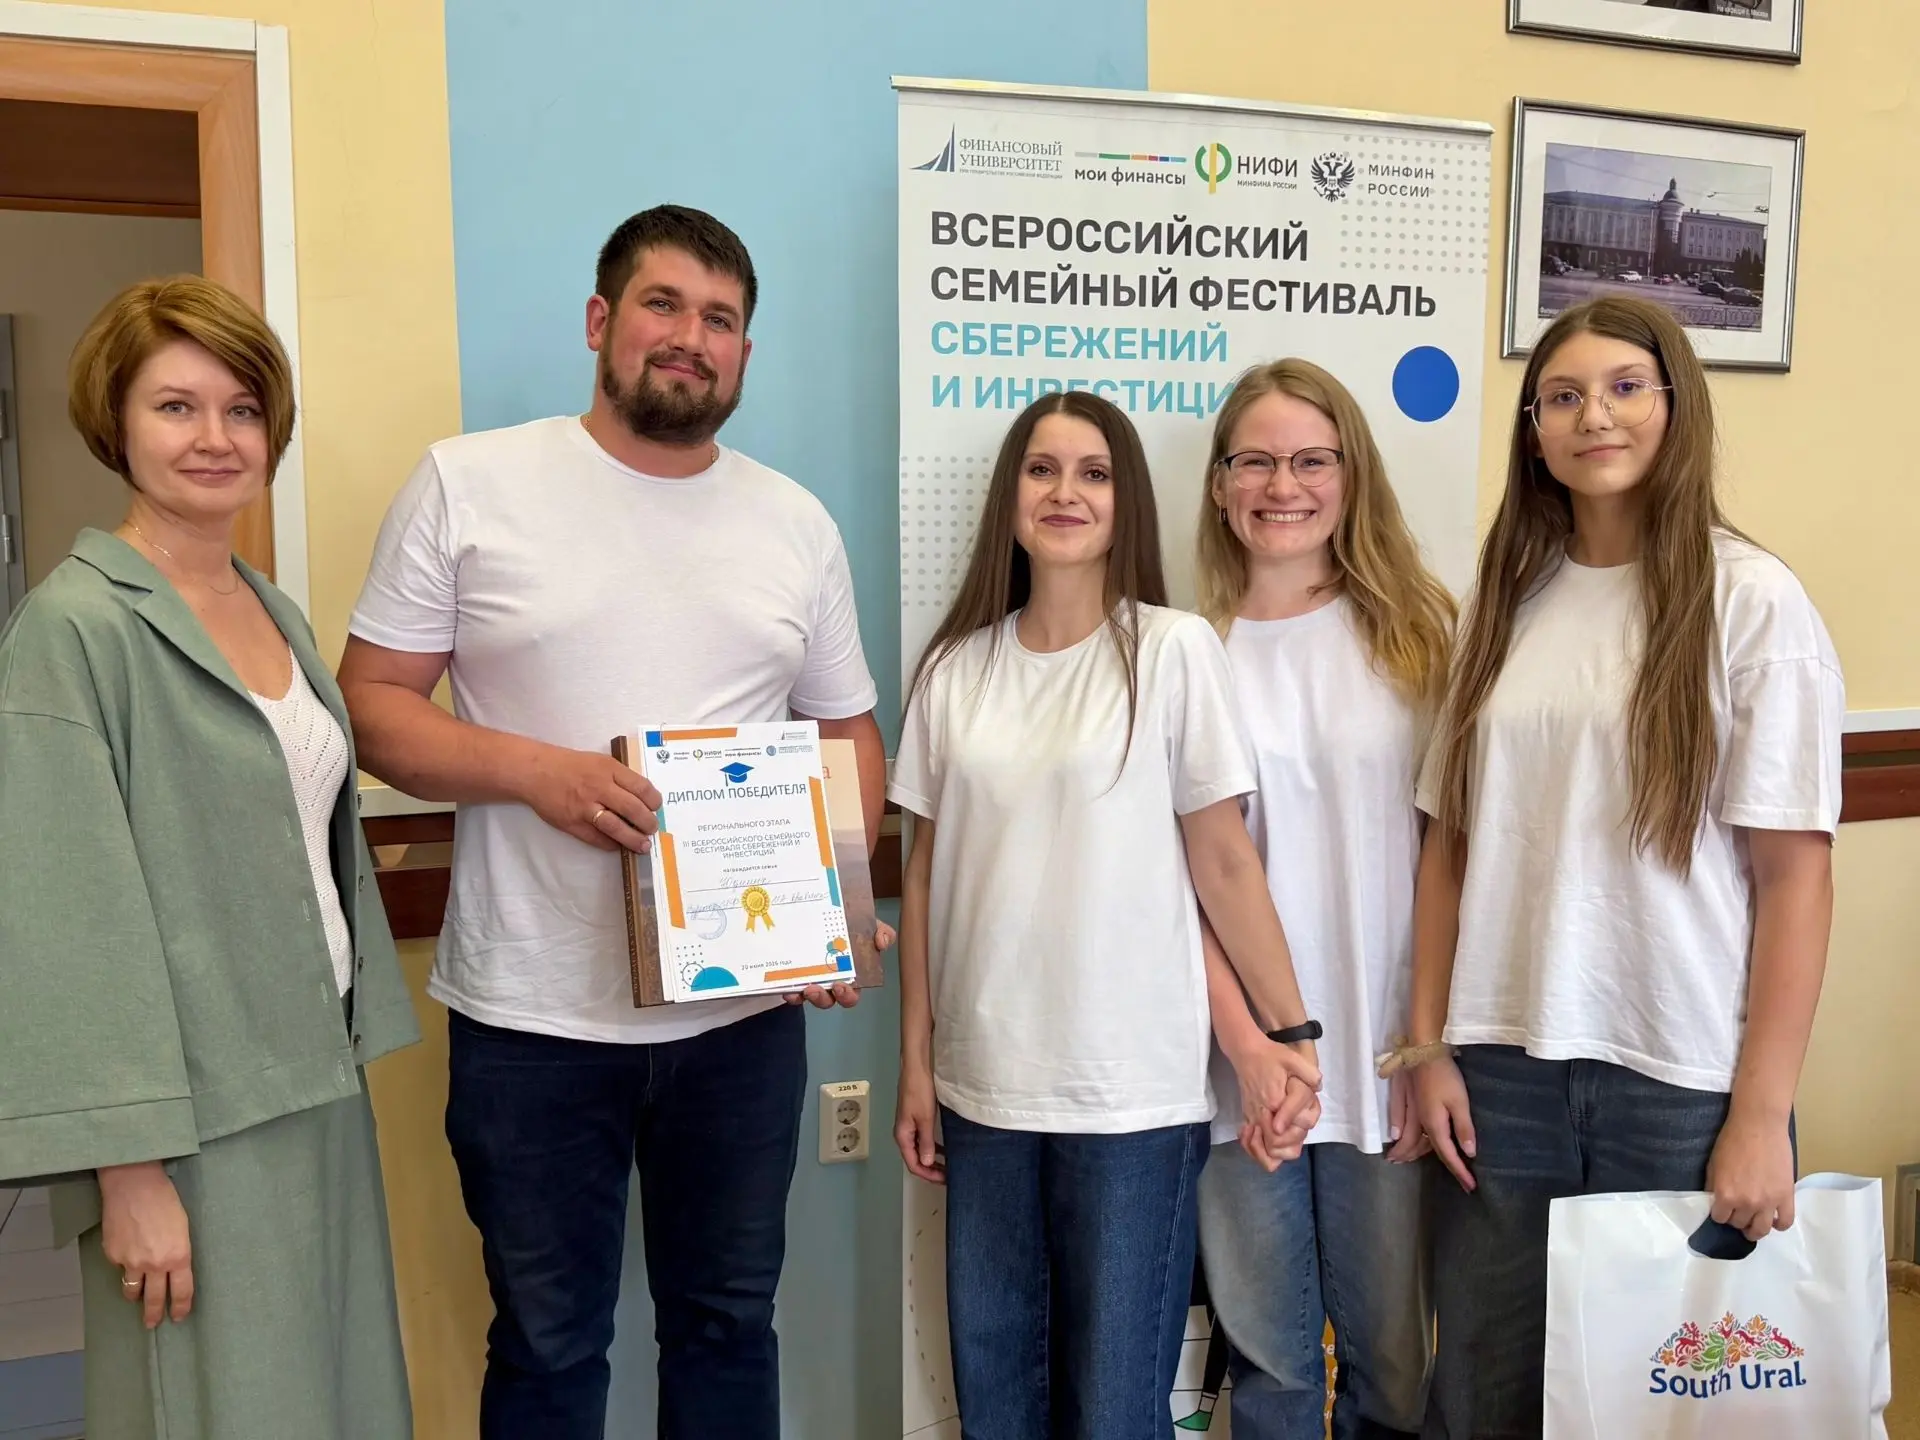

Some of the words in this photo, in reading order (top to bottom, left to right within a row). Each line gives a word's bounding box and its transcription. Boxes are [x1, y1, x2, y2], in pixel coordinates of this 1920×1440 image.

[959, 138, 1063, 156] ФИНАНСОВЫЙ
[959, 154, 1062, 172] УНИВЕРСИТЕТ
[1237, 155, 1298, 178] НИФИ
[1368, 164, 1434, 179] МИНФИН
[1074, 167, 1107, 182] мои
[1111, 166, 1186, 186] финансы
[1237, 180, 1271, 188] МИНФИНА
[1273, 181, 1298, 190] РОССИИ
[1368, 184, 1430, 198] РОССИИ
[931, 211, 1308, 262] ВСЕРОССИЙСКИЙ
[931, 263, 1178, 308] СЕМЕЙНЫЙ
[1189, 275, 1437, 317] ФЕСТИВАЛЬ
[931, 321, 1228, 362] СБЕРЕЖЕНИЙ
[932, 375, 961, 408] И
[667, 789, 725, 804] ДИПЛОМ
[728, 783, 807, 799] ПОБЕДИТЕЛЯ
[697, 820, 765, 832] РЕГИОНАЛЬНОГО
[766, 818, 791, 827] ЭТАПА
[691, 835, 763, 848] ВСЕРОССИЙСКОГО
[764, 831, 811, 841] СЕМЕЙНОГО
[694, 844, 741, 855] ФЕСТИВАЛЯ
[742, 839, 794, 851] СБЕРЕЖЕНИЙ
[722, 848, 775, 859] ИНВЕСТИЦИЙ
[1649, 1366, 1731, 1399] South
[1739, 1360, 1807, 1390] Ural
